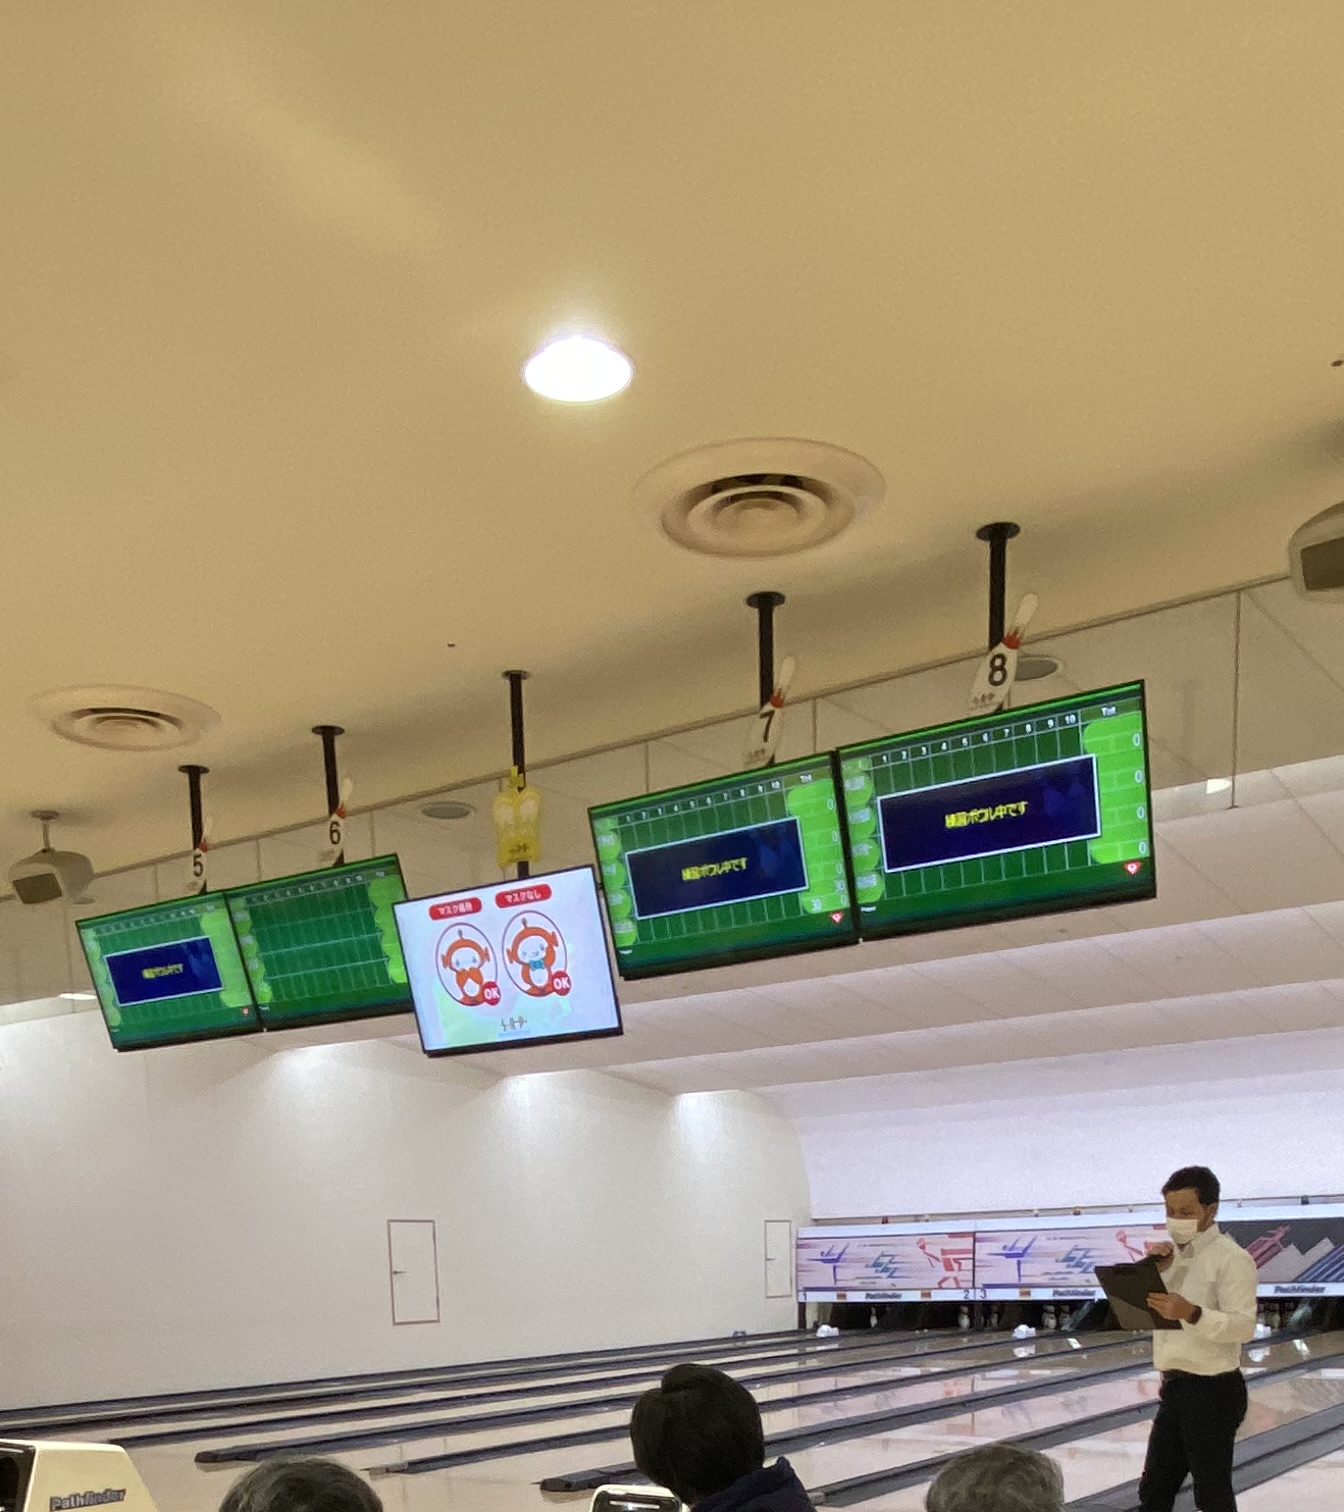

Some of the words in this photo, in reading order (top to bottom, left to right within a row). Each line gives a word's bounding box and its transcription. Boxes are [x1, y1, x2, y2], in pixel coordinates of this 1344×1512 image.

[988, 653, 1007, 686] 8
[759, 711, 775, 742] 7
[329, 821, 340, 844] 6
[193, 853, 203, 877] 5
[483, 985, 501, 1001] OK
[553, 975, 571, 992] OK
[963, 1289, 970, 1299] 2
[980, 1289, 987, 1299] 3
[49, 1488, 127, 1512] Pathfinder
